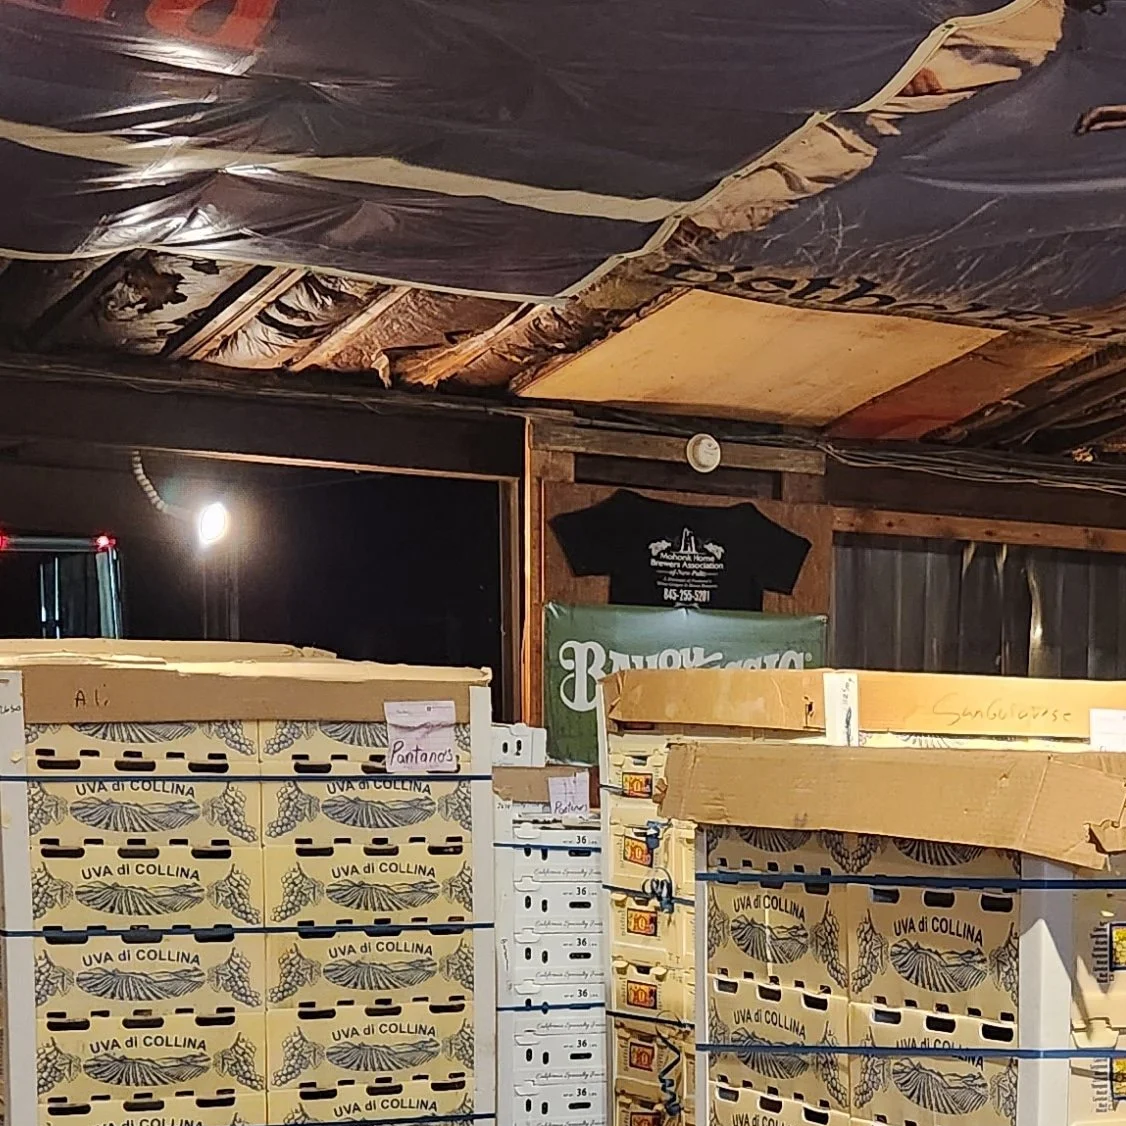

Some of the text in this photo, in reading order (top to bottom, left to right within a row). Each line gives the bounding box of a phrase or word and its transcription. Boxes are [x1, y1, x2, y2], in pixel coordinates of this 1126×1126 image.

[682, 562, 724, 570] Association
[576, 836, 586, 844] 36
[82, 863, 200, 881] UVA di COLLINA
[331, 862, 436, 878] UVA di COLLINA
[576, 887, 586, 895] 36
[734, 894, 806, 922] UVA di COLLINA
[894, 917, 982, 947] UVA di COLLINA
[577, 938, 587, 946] 36
[329, 942, 434, 958] UVA di COLLINA
[82, 948, 200, 968] UVA di COLLINA
[578, 989, 588, 997] 36
[89, 1036, 206, 1054] UVA di COLLINA
[577, 1040, 587, 1048] 36
[577, 1088, 587, 1096] 36
[334, 1098, 438, 1118] UVA di COLLINA
[751, 1114, 760, 1126] di
